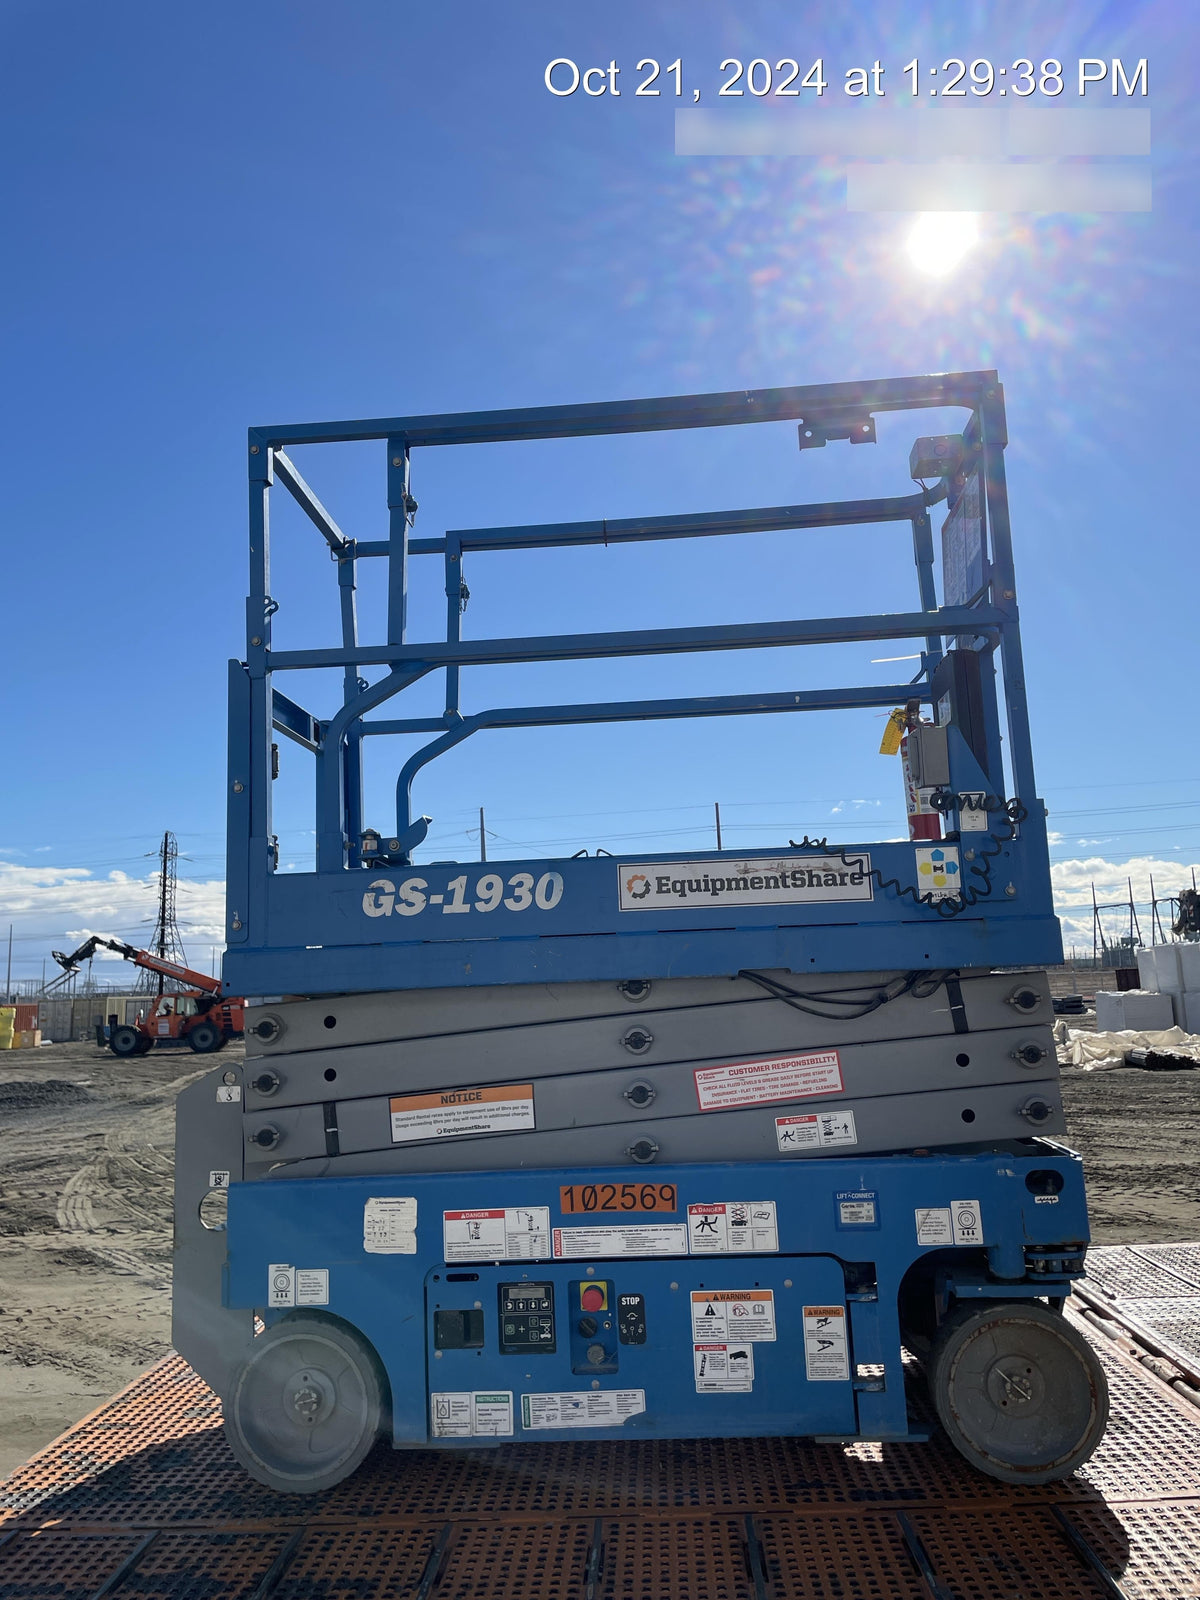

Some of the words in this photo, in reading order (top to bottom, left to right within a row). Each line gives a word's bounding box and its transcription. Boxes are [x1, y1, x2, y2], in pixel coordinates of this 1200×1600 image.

[655, 869, 865, 898] EquipmentShare
[362, 872, 564, 918] GS-1930
[728, 1064, 770, 1076] CUSTOMER
[772, 1056, 836, 1070] RESPONSIBILITY
[440, 1092, 482, 1104] NOTICE
[443, 1124, 491, 1134] EquipmentShare
[564, 1184, 676, 1212] 102569
[621, 1297, 640, 1306] STOP
